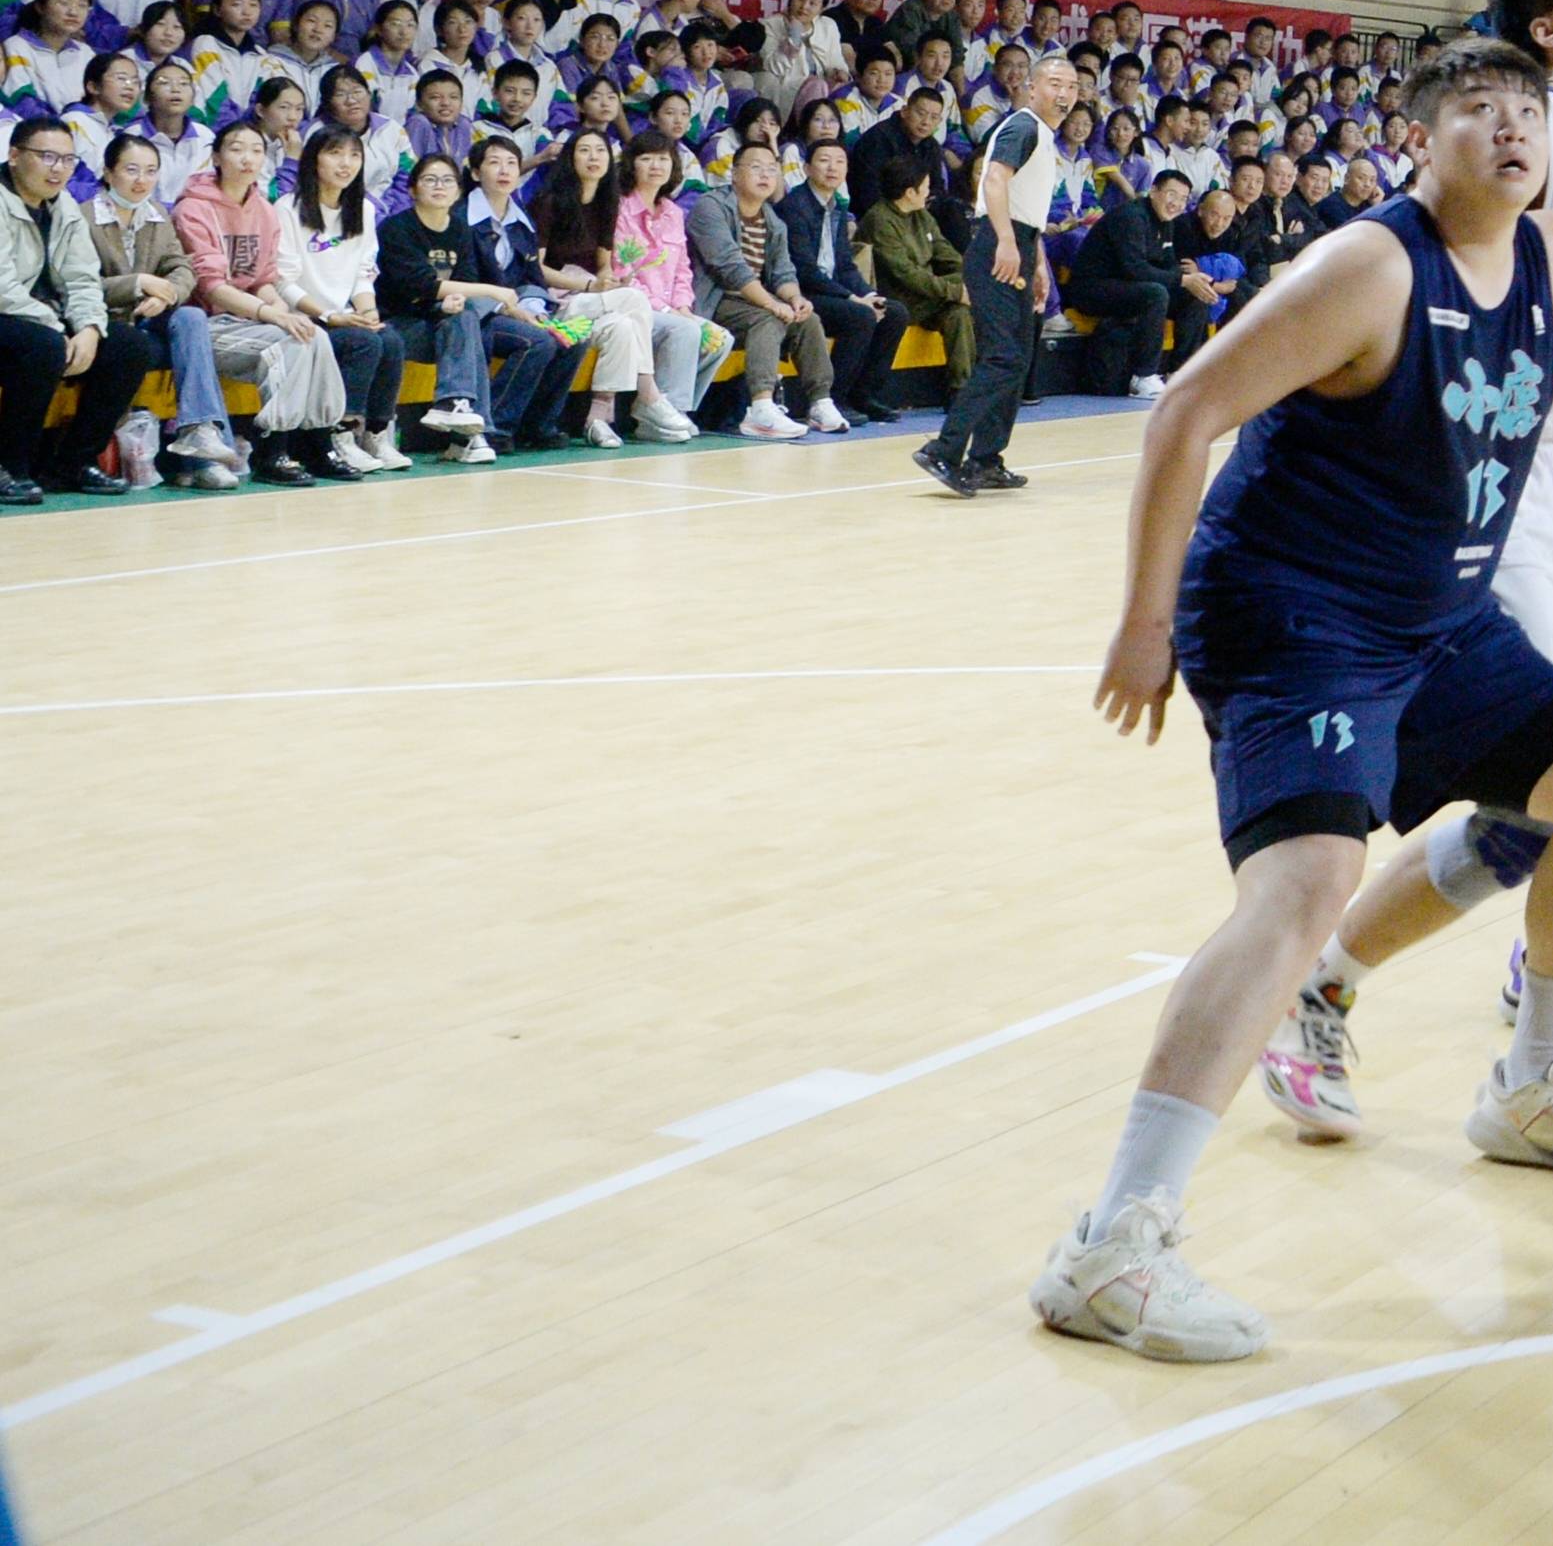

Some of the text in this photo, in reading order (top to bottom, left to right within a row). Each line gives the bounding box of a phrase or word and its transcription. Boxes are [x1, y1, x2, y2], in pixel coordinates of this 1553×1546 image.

[1441, 348, 1545, 441] 小店
[1465, 457, 1510, 530] 13
[1308, 710, 1355, 754] 13
